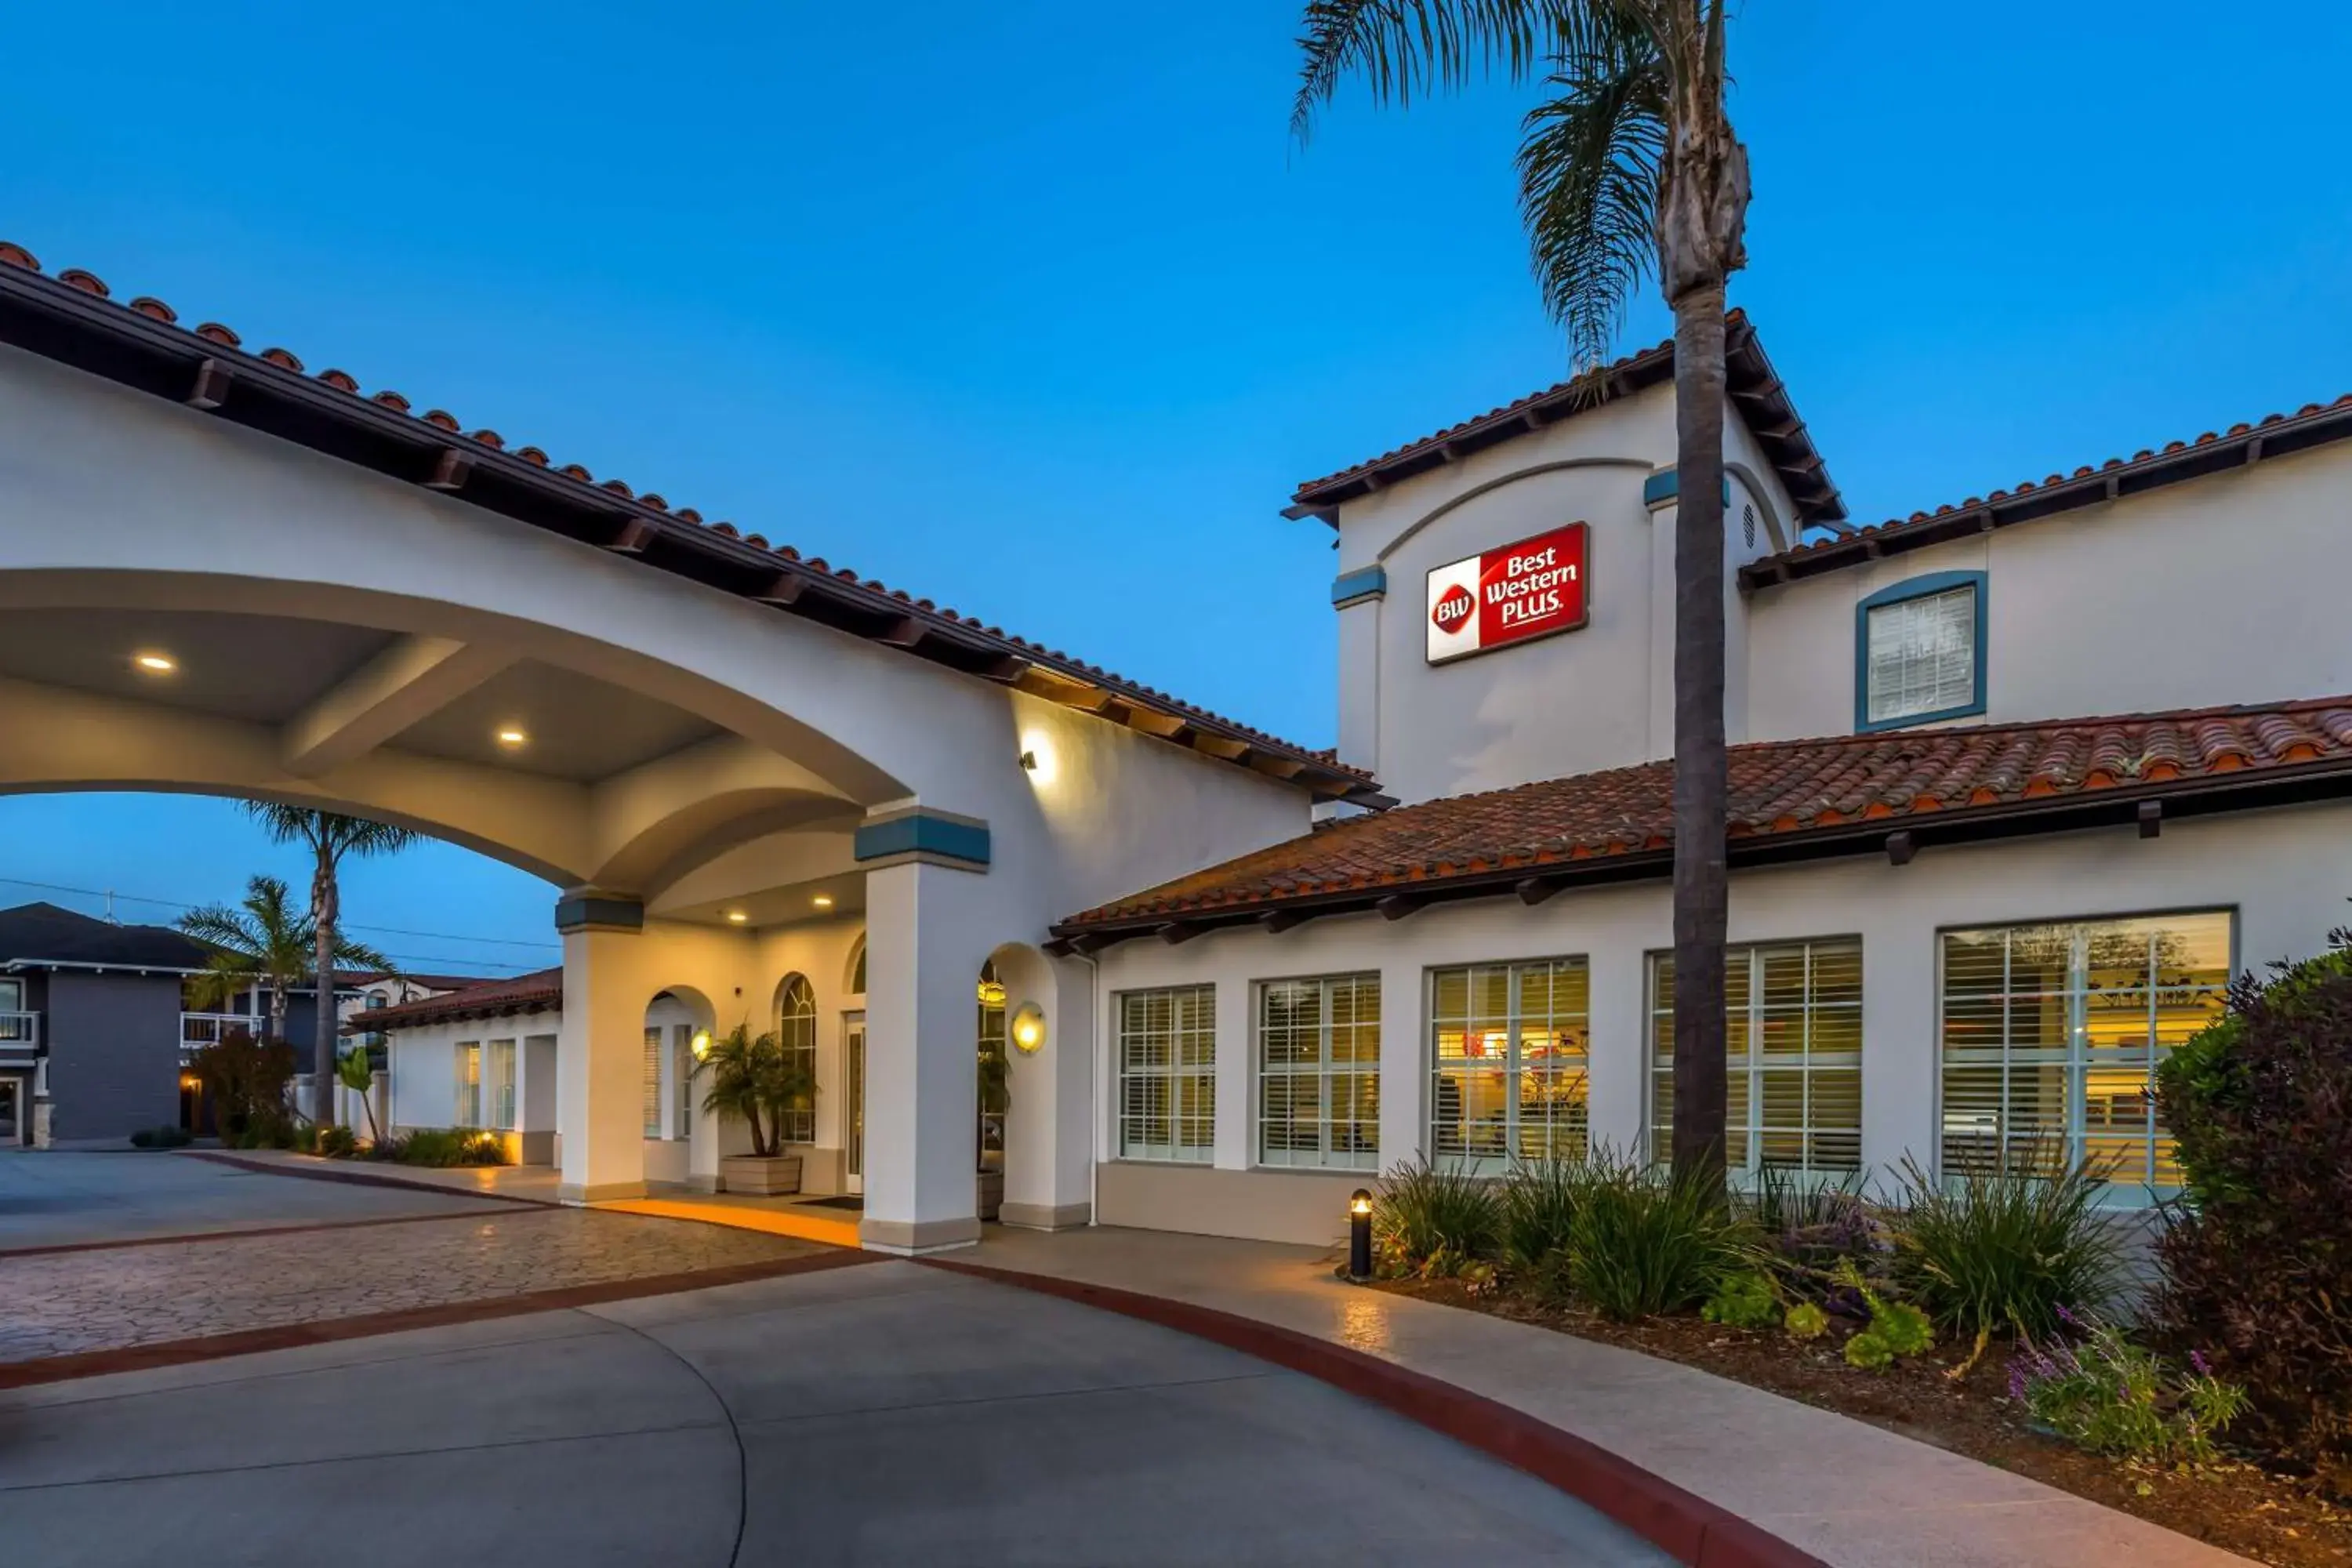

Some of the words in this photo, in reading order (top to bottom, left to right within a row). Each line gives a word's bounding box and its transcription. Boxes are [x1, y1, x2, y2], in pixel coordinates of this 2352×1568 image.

[1508, 546, 1556, 577] Best
[1486, 564, 1577, 604] Western
[1437, 595, 1469, 623] BW
